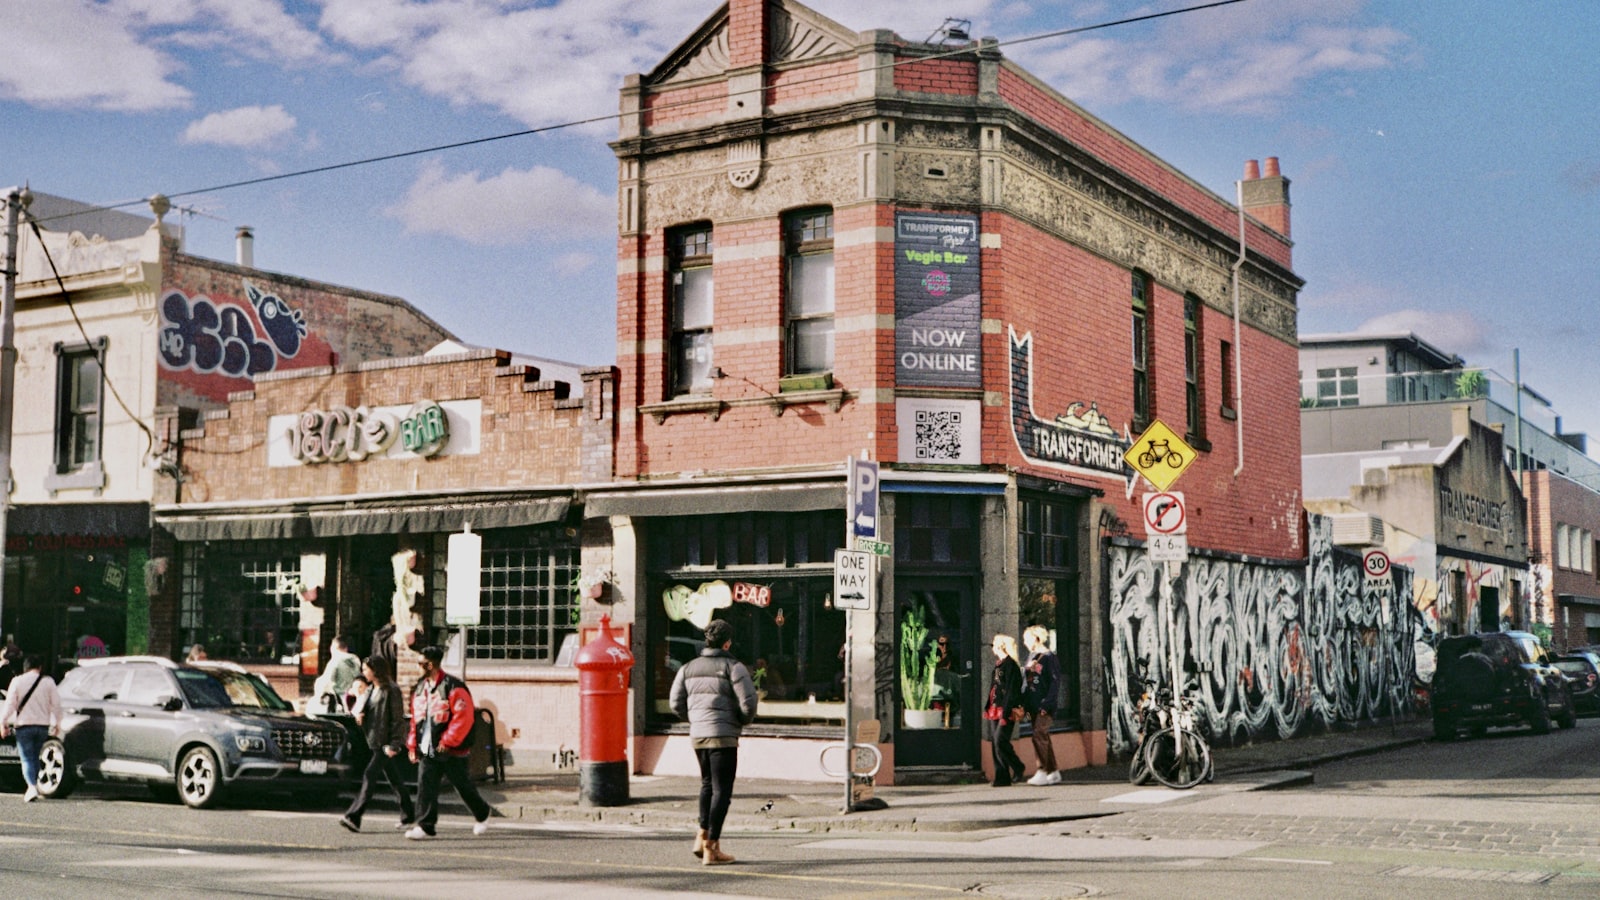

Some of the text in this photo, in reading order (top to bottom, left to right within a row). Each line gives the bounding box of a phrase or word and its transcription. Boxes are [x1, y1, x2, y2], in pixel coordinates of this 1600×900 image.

[904, 222, 970, 235] TRANSFORMER
[905, 249, 968, 265] Vegie Bar
[911, 328, 967, 348] NOW
[901, 351, 977, 372] ONLINE
[401, 406, 444, 451] BAR
[1032, 426, 1124, 471] TRANSFORMER
[855, 466, 876, 505] P
[1440, 485, 1501, 531] TRANSFORMER
[858, 540, 877, 554] ROSE
[841, 555, 865, 570] ONE
[1369, 557, 1386, 570] 30
[840, 573, 867, 589] WAY
[1367, 578, 1392, 588] AREA
[734, 584, 769, 606] BAR
